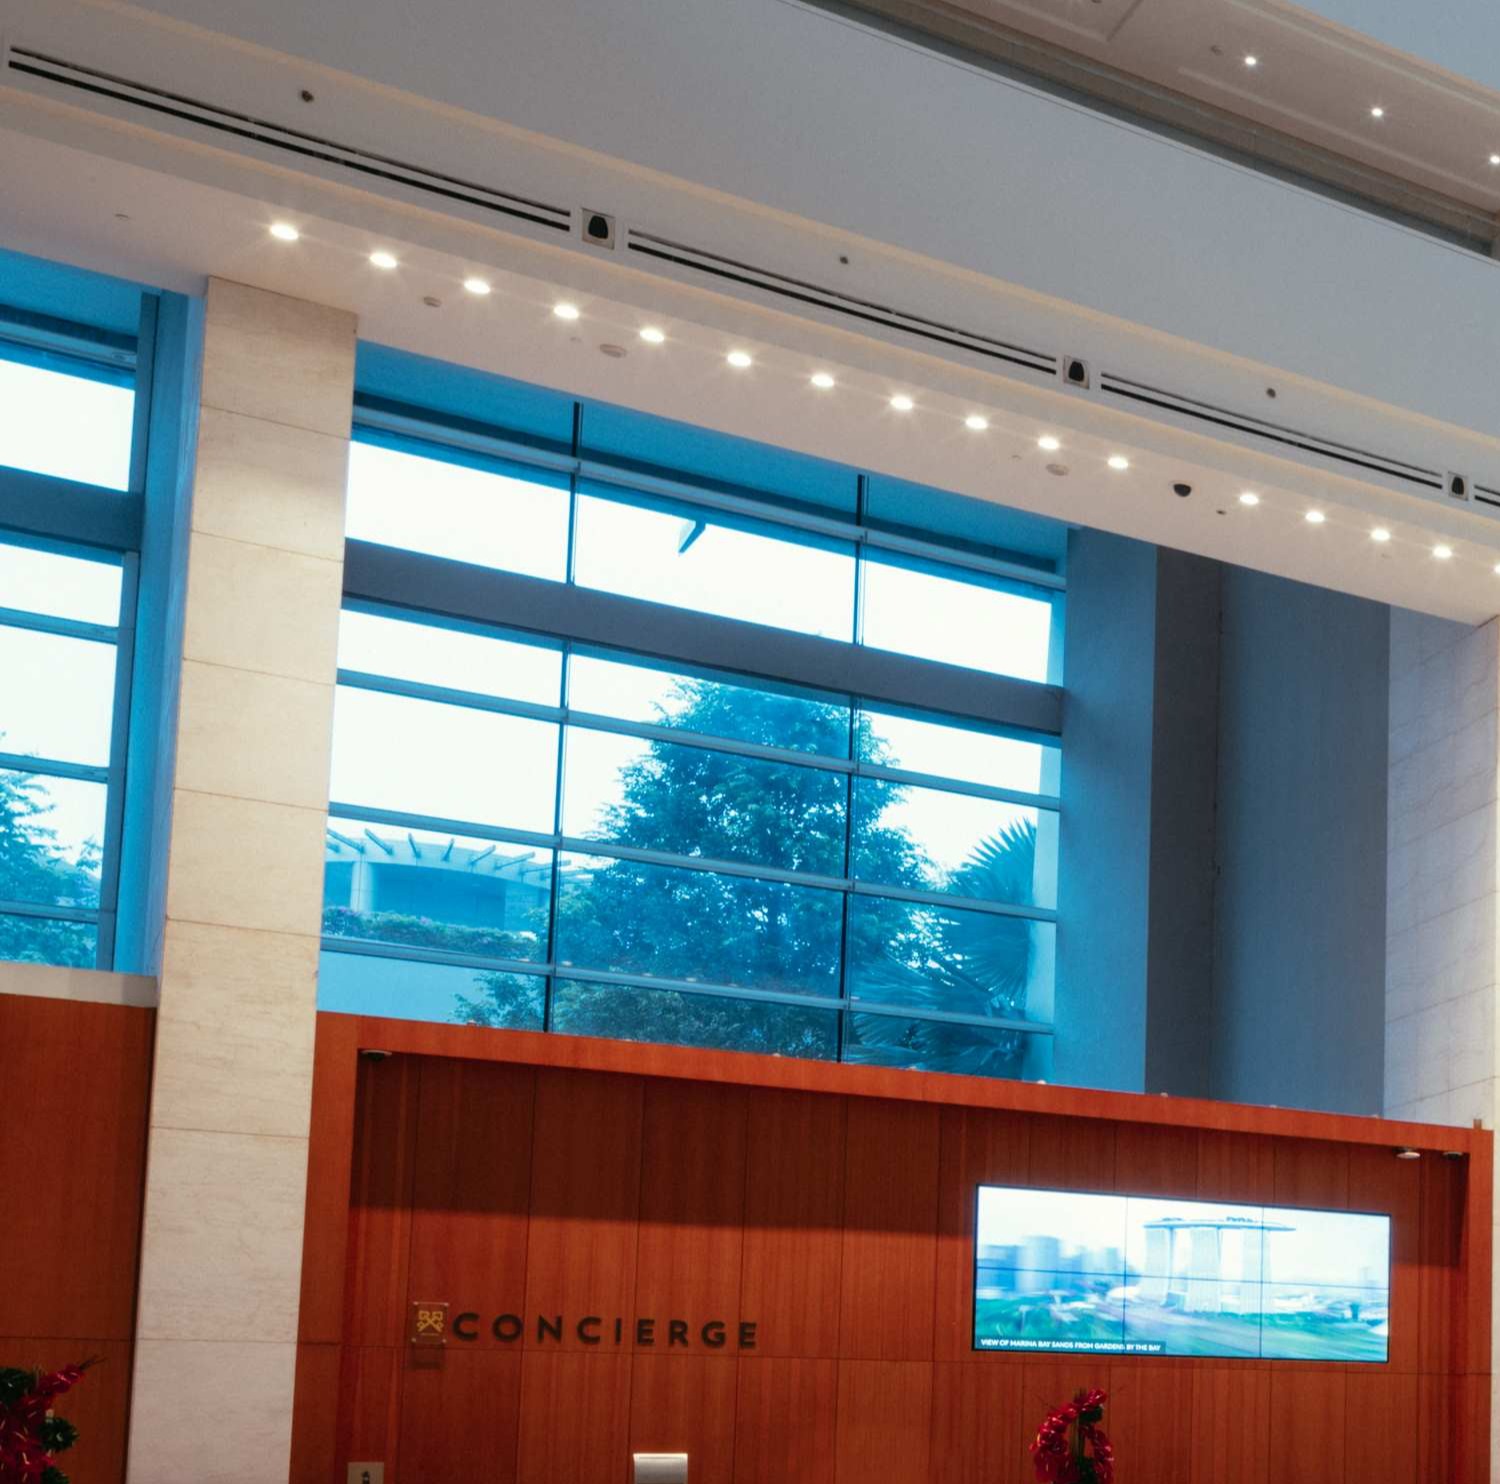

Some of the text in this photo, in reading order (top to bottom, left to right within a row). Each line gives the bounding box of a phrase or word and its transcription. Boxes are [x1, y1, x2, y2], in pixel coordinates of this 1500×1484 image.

[452, 1311, 757, 1348] CONCIERGE
[1000, 1339, 1009, 1347] OF
[1051, 1341, 1073, 1349] SANDS
